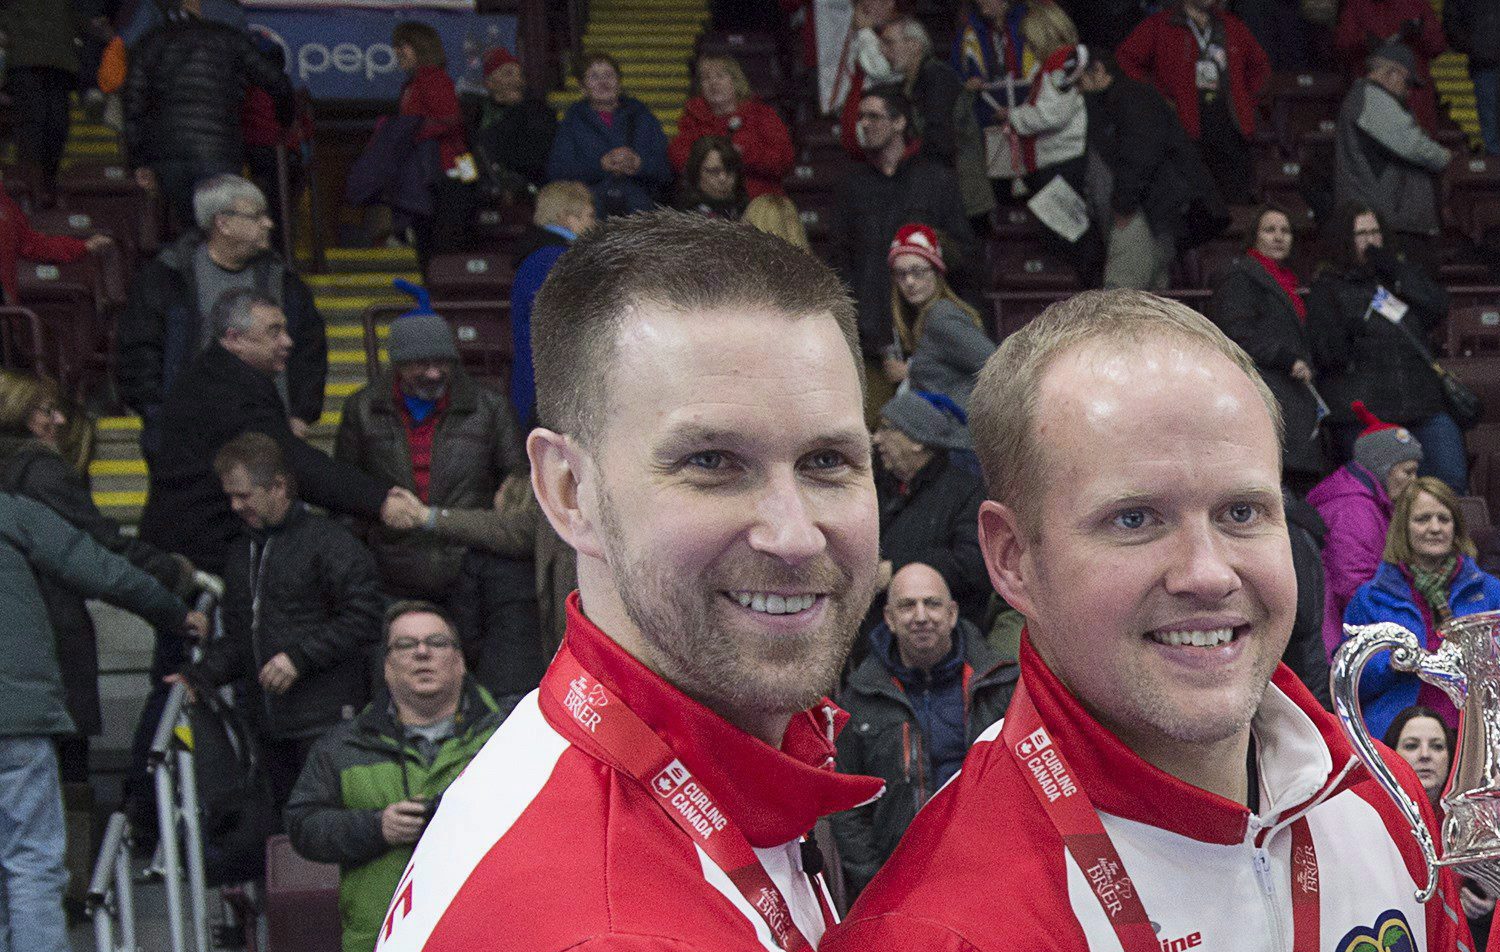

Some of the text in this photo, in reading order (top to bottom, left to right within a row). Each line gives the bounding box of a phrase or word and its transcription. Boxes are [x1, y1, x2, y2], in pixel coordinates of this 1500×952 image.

[298, 42, 400, 80] pep
[563, 690, 602, 733] BRIER
[1027, 757, 1064, 803] CANADA
[1040, 748, 1077, 798] CURLING
[671, 793, 714, 840] CANADA
[682, 781, 728, 832] CURLING
[1087, 863, 1125, 918] BRIER
